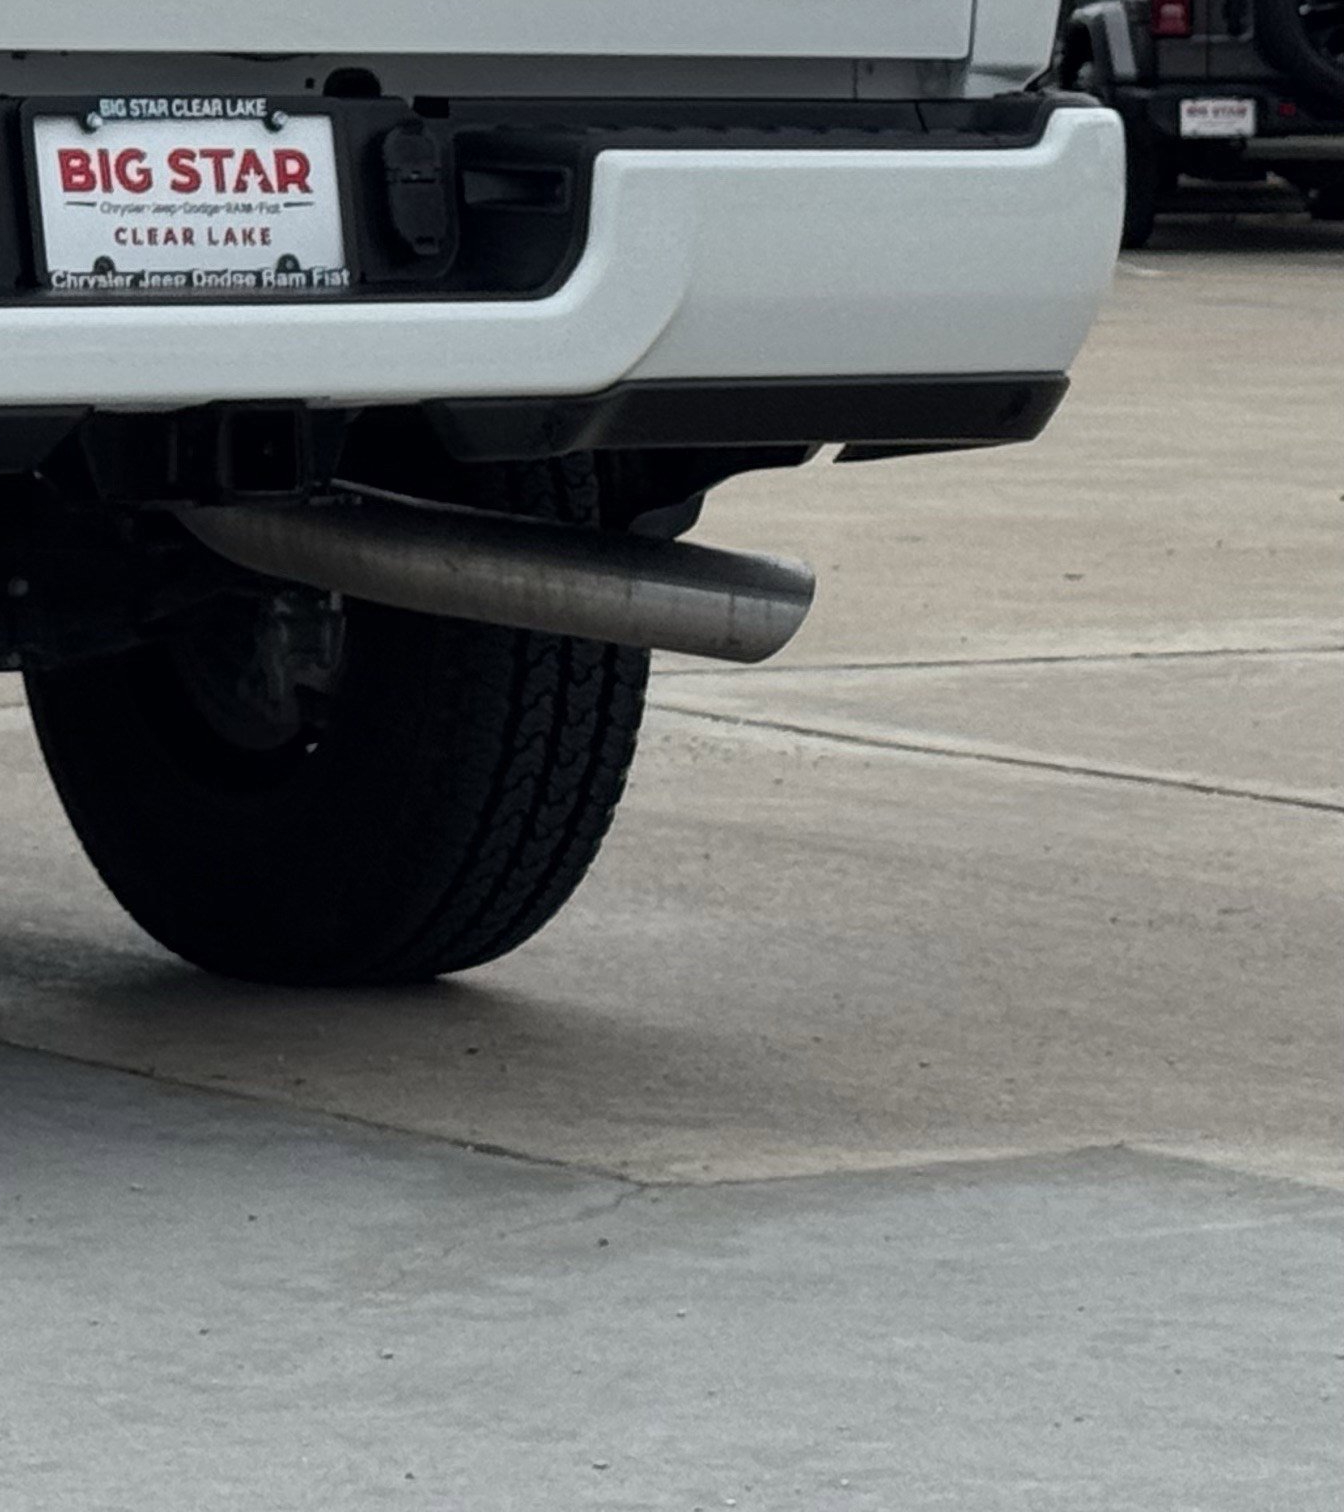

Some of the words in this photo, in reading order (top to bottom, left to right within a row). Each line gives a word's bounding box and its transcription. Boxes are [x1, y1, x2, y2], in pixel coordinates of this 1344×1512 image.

[99, 98, 127, 117] BIG
[129, 98, 169, 117] STAR
[172, 98, 223, 117] CLEAR
[226, 98, 268, 117] LAKE
[57, 148, 153, 194] BIG
[167, 148, 314, 194] STAR
[114, 227, 195, 246] CLEAR
[207, 227, 272, 246] LAKE
[51, 270, 132, 288] Chrysler
[139, 270, 186, 288] Jeep
[192, 269, 256, 288] Dodge
[262, 268, 306, 287] Ram
[312, 267, 350, 286] Fiat
